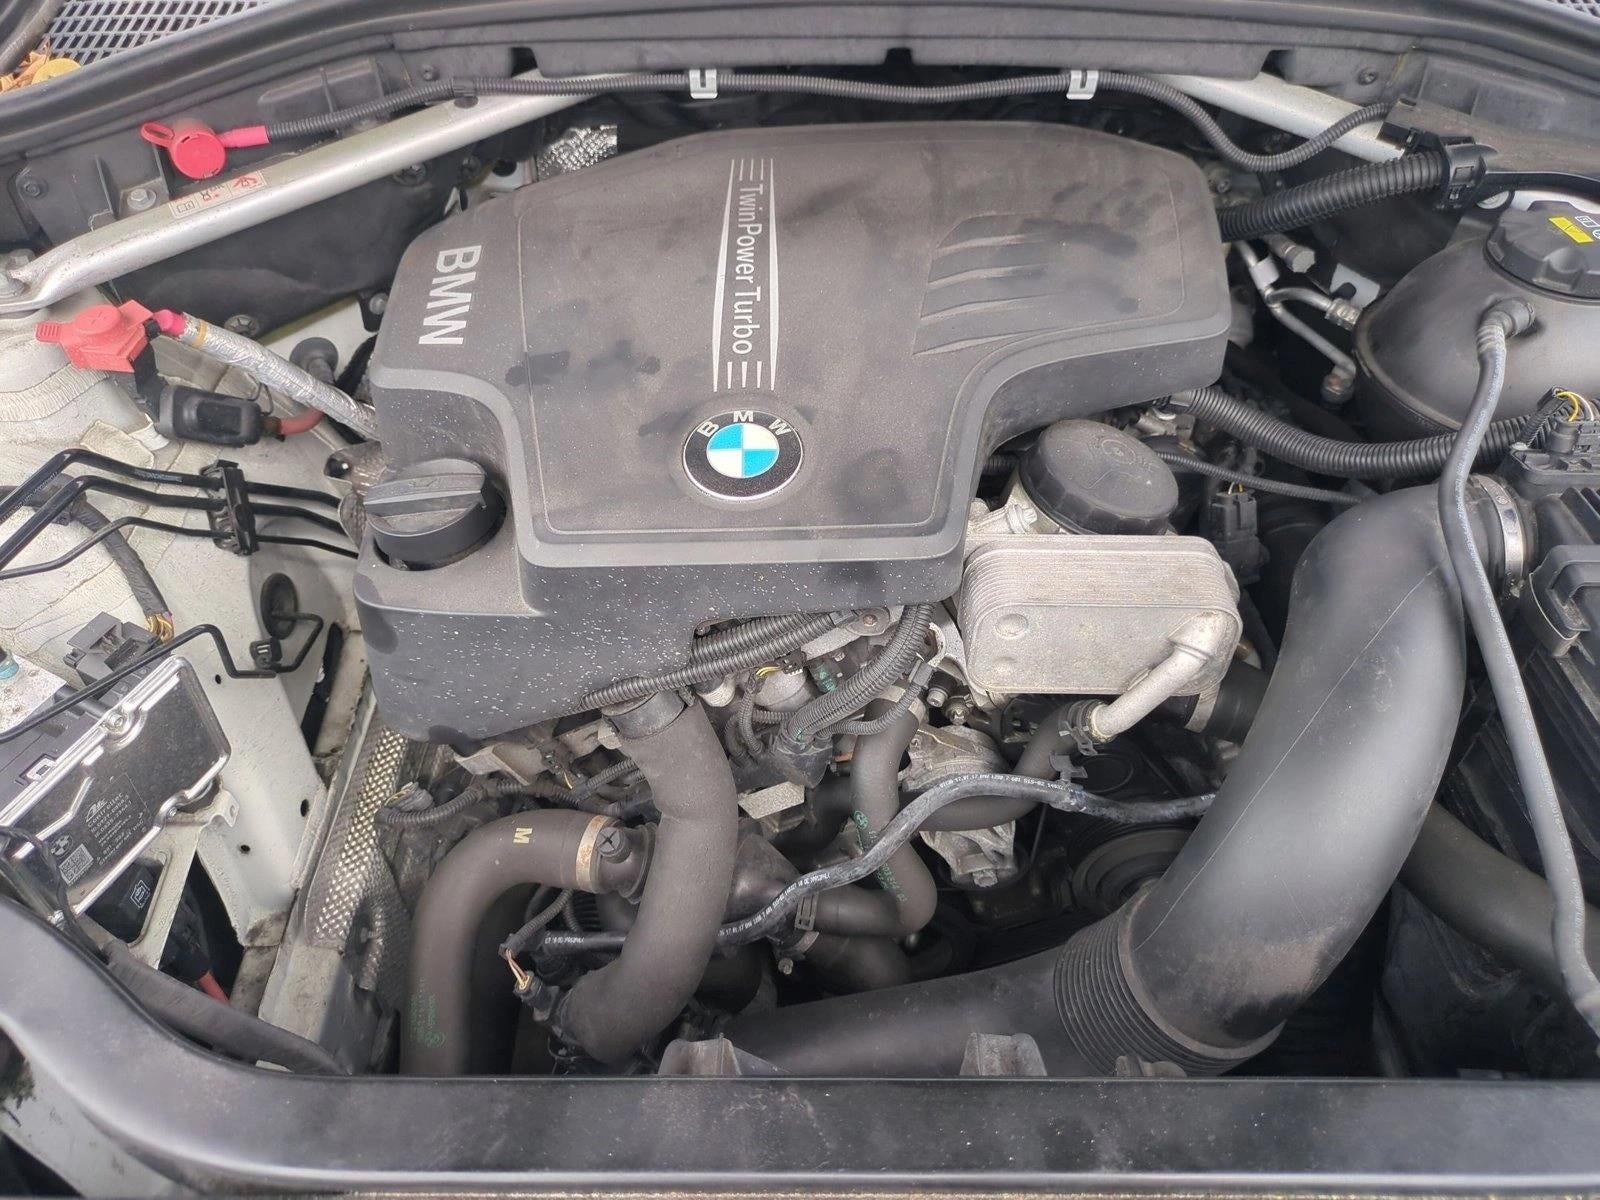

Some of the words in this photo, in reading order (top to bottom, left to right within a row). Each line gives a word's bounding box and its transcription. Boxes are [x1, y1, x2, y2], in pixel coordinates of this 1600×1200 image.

[735, 184, 764, 284] TwinPower
[418, 245, 482, 345] BMW
[731, 286, 761, 355] Turbo
[696, 410, 792, 437] BMW
[513, 827, 533, 844] M
